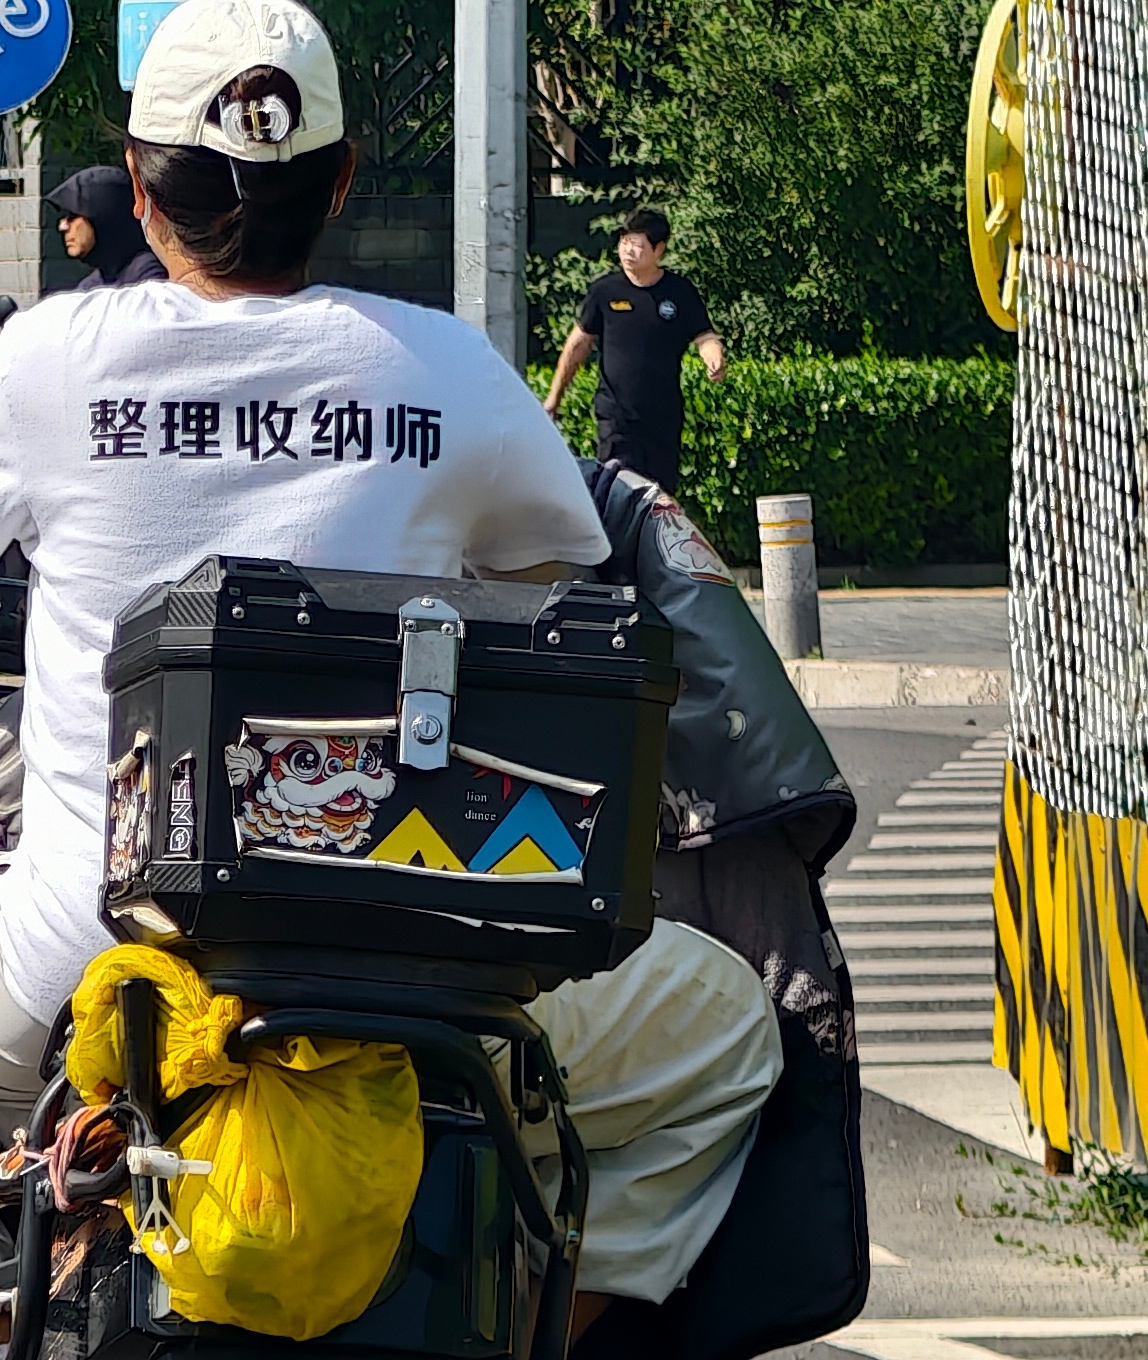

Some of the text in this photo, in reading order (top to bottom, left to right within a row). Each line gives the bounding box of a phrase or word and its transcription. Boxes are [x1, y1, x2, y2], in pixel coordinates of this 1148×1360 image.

[88, 397, 442, 468] 整理收纳师
[466, 791, 488, 803] lion
